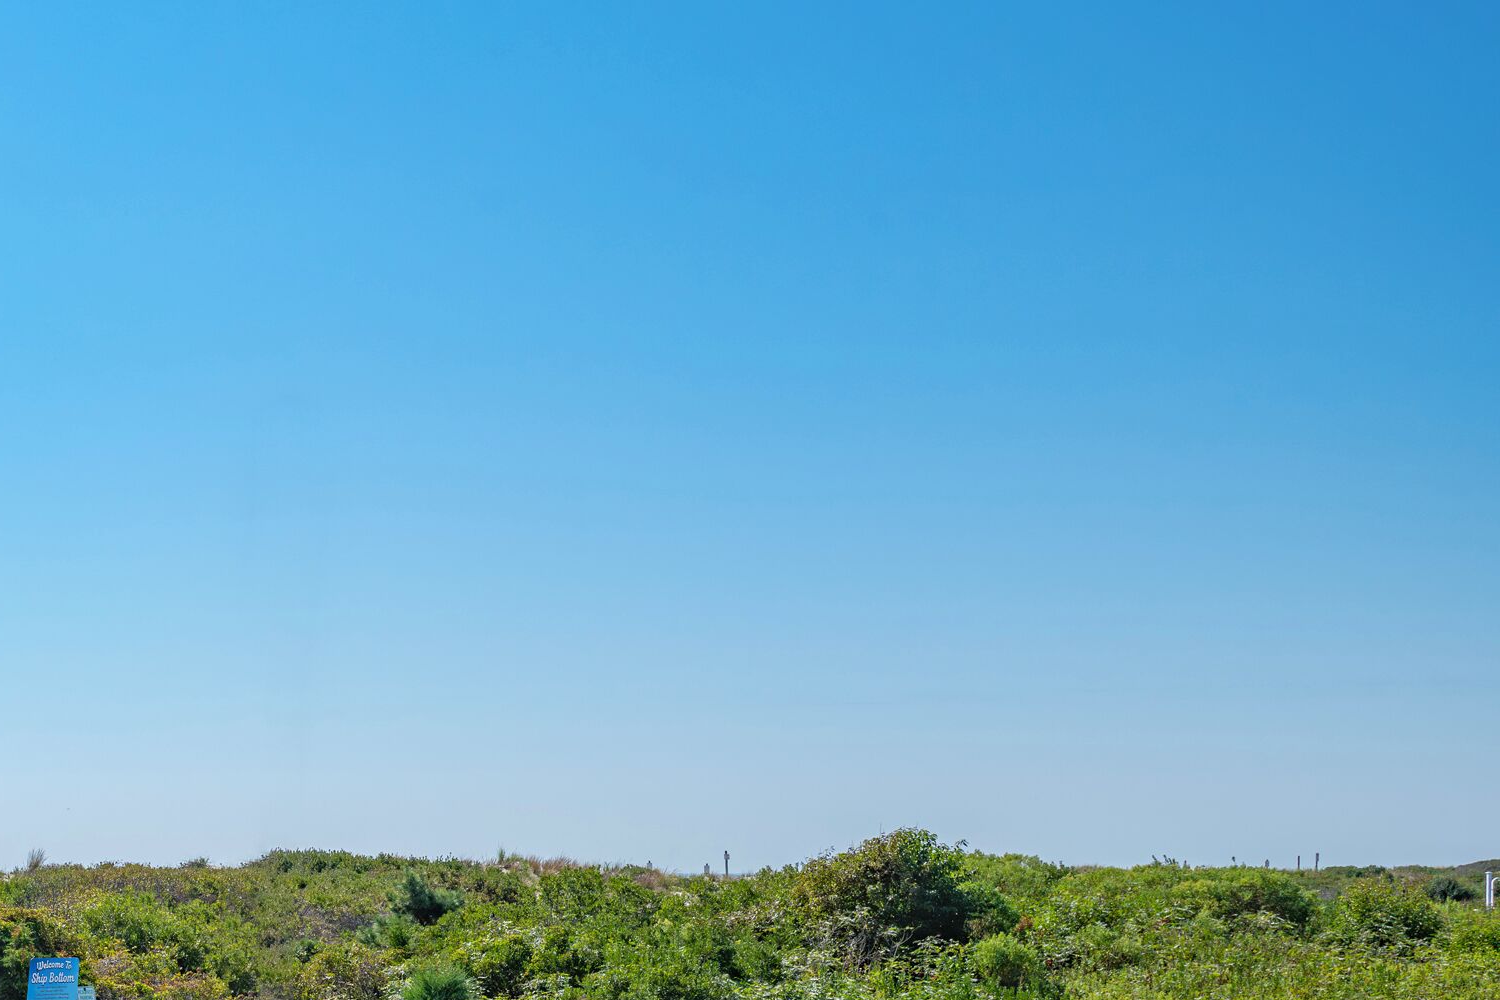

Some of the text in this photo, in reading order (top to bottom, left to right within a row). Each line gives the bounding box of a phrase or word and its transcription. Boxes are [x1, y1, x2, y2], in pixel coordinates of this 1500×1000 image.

[36, 960, 72, 970] Welcome To
[31, 972, 75, 984] Ship Bottom
